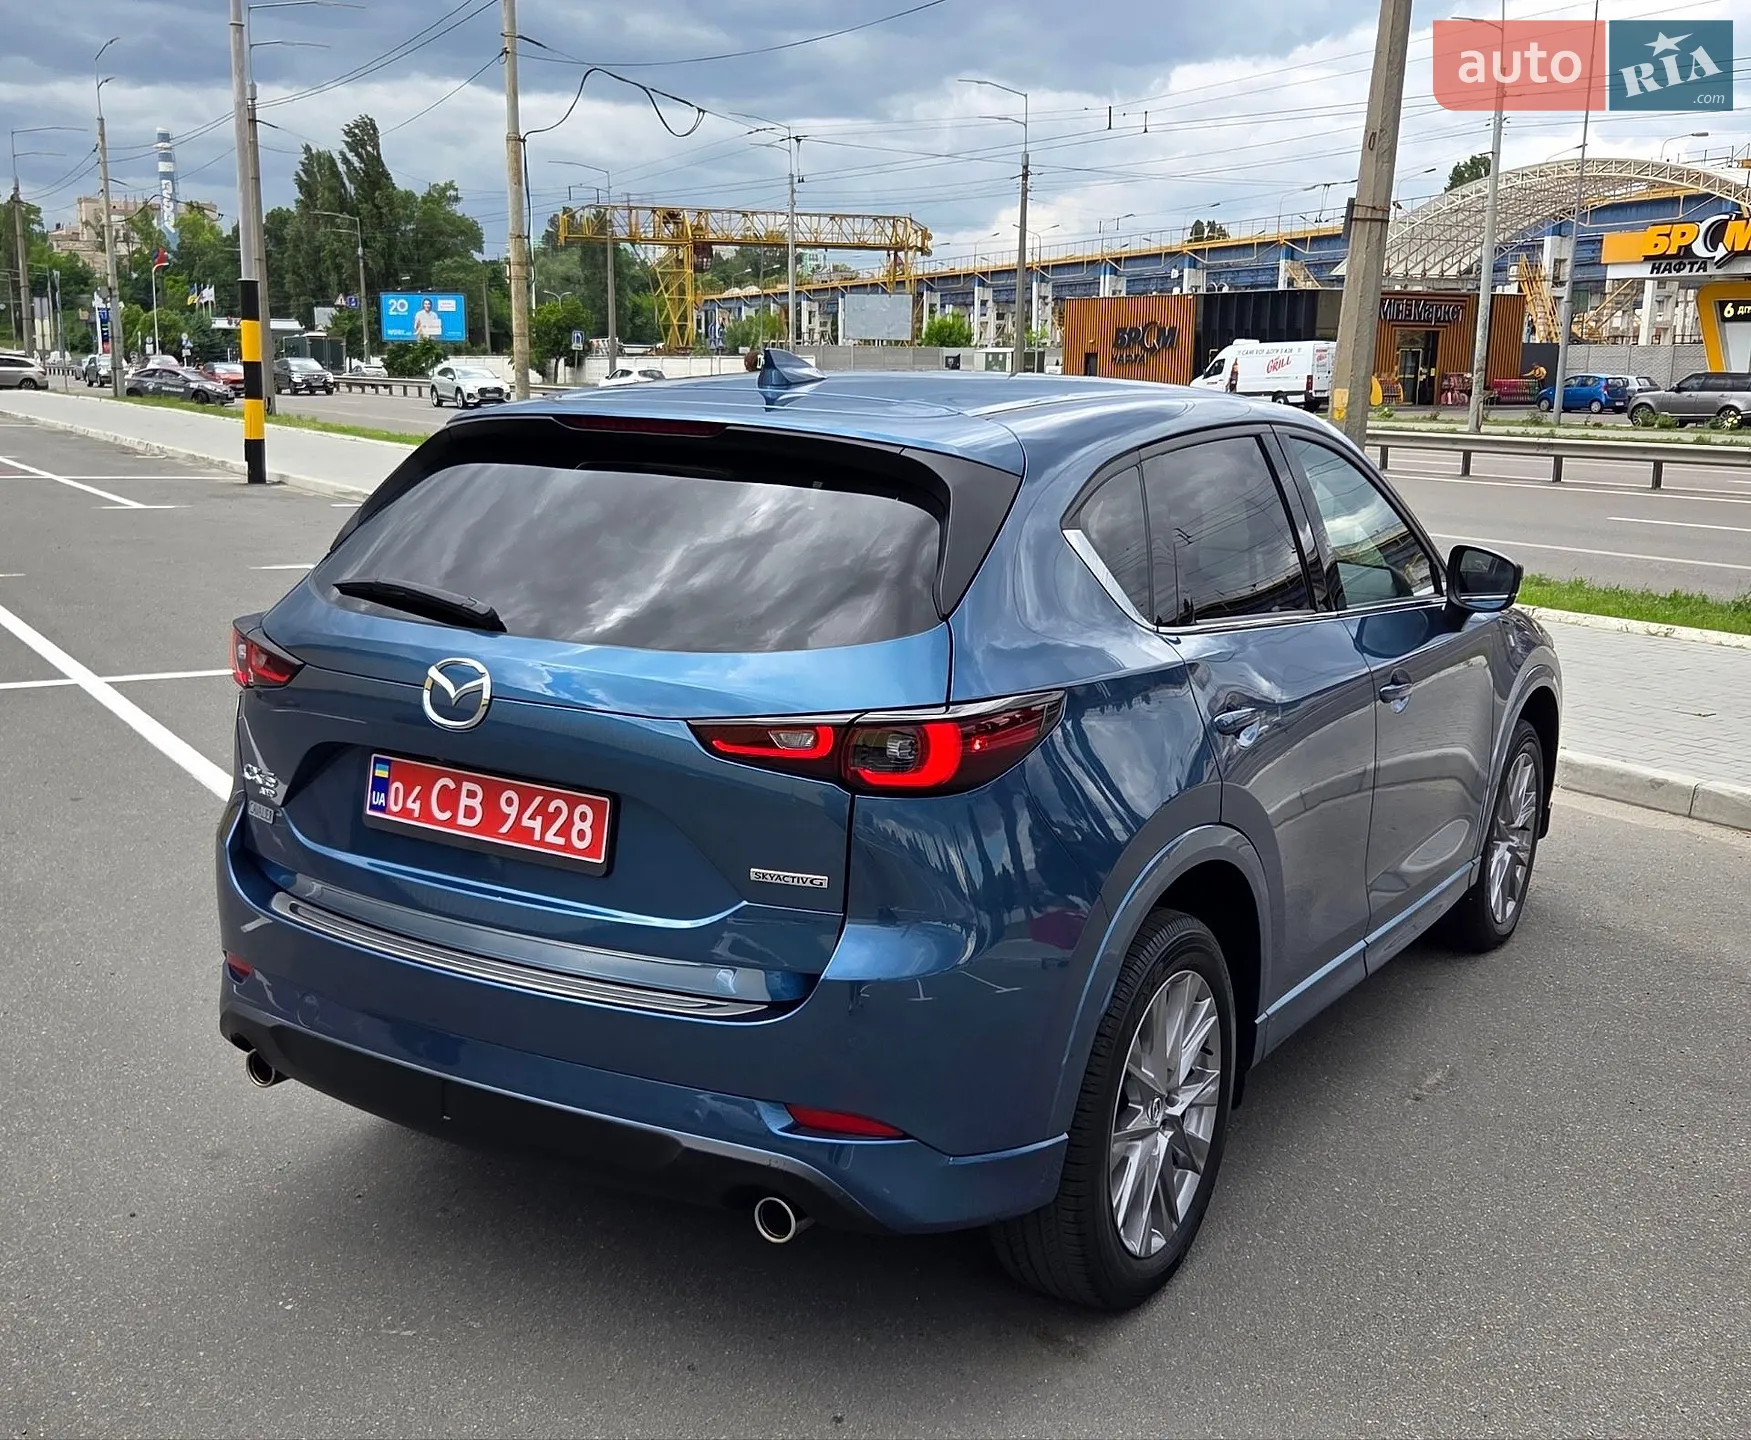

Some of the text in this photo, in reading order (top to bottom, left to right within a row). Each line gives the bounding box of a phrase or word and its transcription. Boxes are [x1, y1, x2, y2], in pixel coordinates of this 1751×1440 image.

[1649, 260, 1708, 275] НАФТА
[1723, 302, 1735, 318] 6
[1266, 356, 1292, 374] GRILL
[372, 791, 386, 807] UA
[389, 782, 422, 818] 04
[498, 790, 594, 850] 9428
